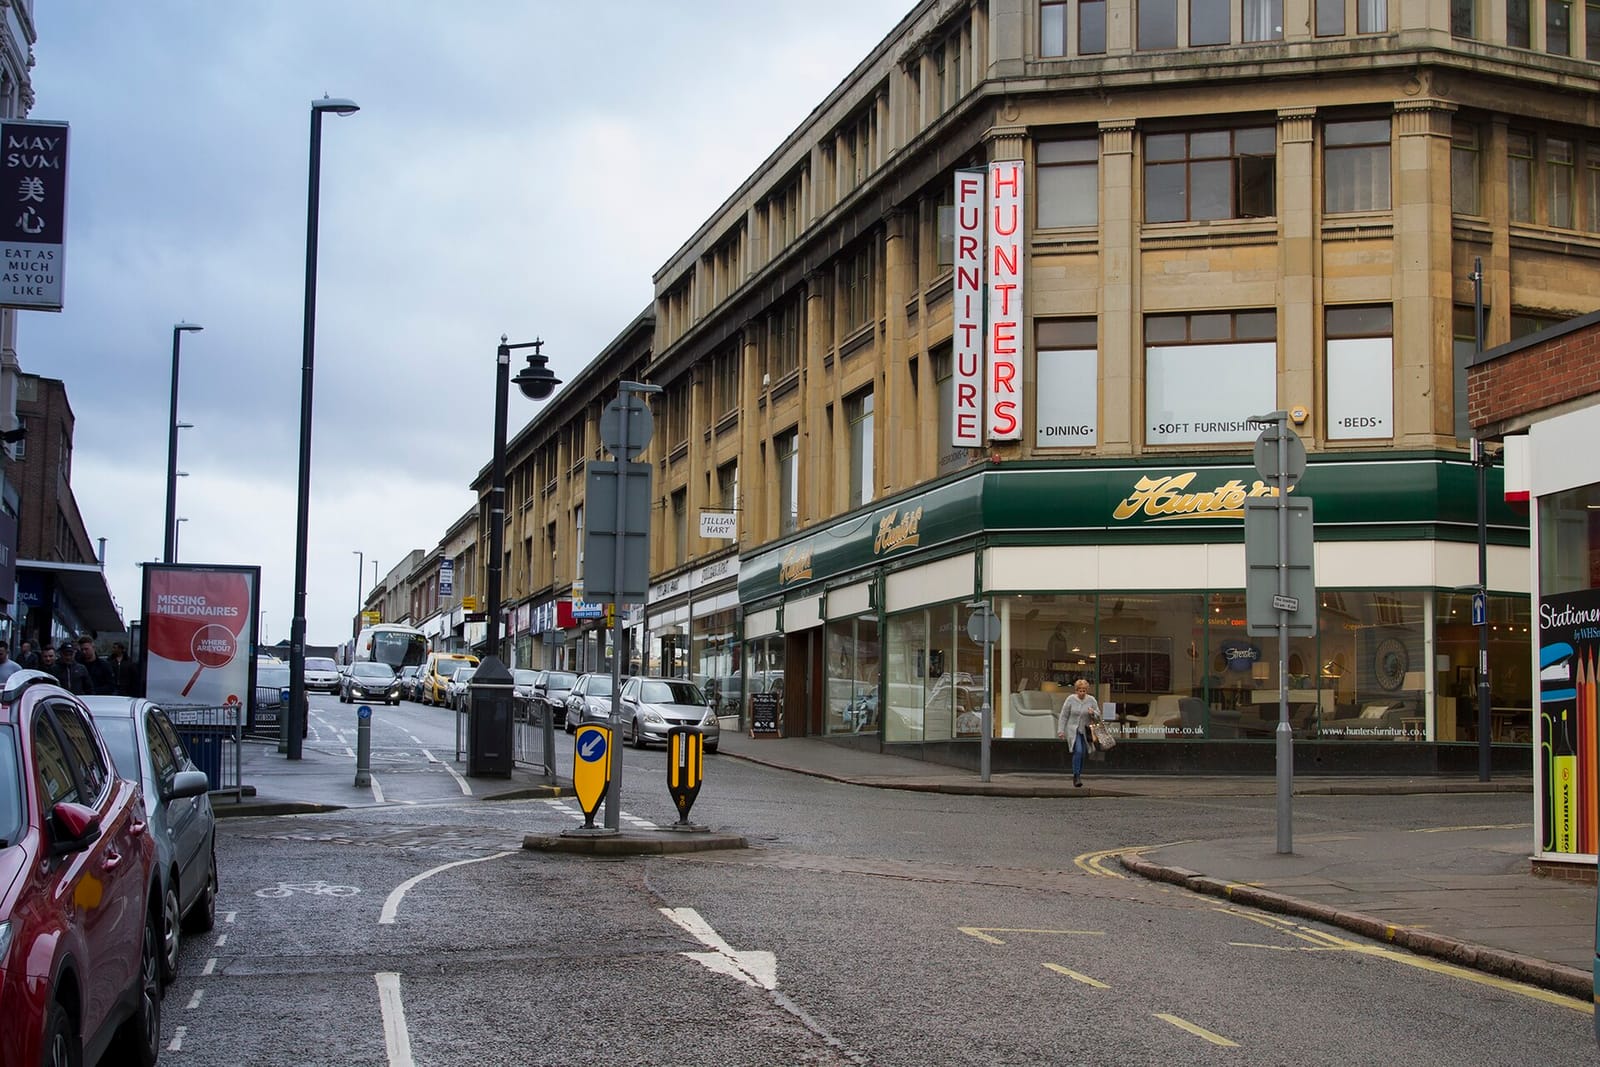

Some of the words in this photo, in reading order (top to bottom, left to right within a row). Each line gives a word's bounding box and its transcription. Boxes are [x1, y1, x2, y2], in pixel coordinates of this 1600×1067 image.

[8, 135, 61, 151] MAY
[7, 153, 60, 169] SUM
[15, 176, 46, 234] 美心
[5, 249, 32, 259] EAT
[37, 250, 54, 260] AS
[8, 261, 49, 272] MUCH
[2, 272, 20, 282] AS
[25, 274, 54, 284] YOU
[12, 286, 43, 296] LIKE
[993, 166, 1018, 436] HUNTERS
[957, 179, 979, 439] FURNITURE
[1344, 417, 1376, 428] BEDS
[1046, 425, 1089, 436] DINING
[1158, 423, 1189, 434] SOFT
[701, 517, 736, 526] JILLIAN
[706, 526, 730, 534] HART
[157, 594, 206, 605] MISSING
[156, 605, 239, 617] MILLIONAIRES
